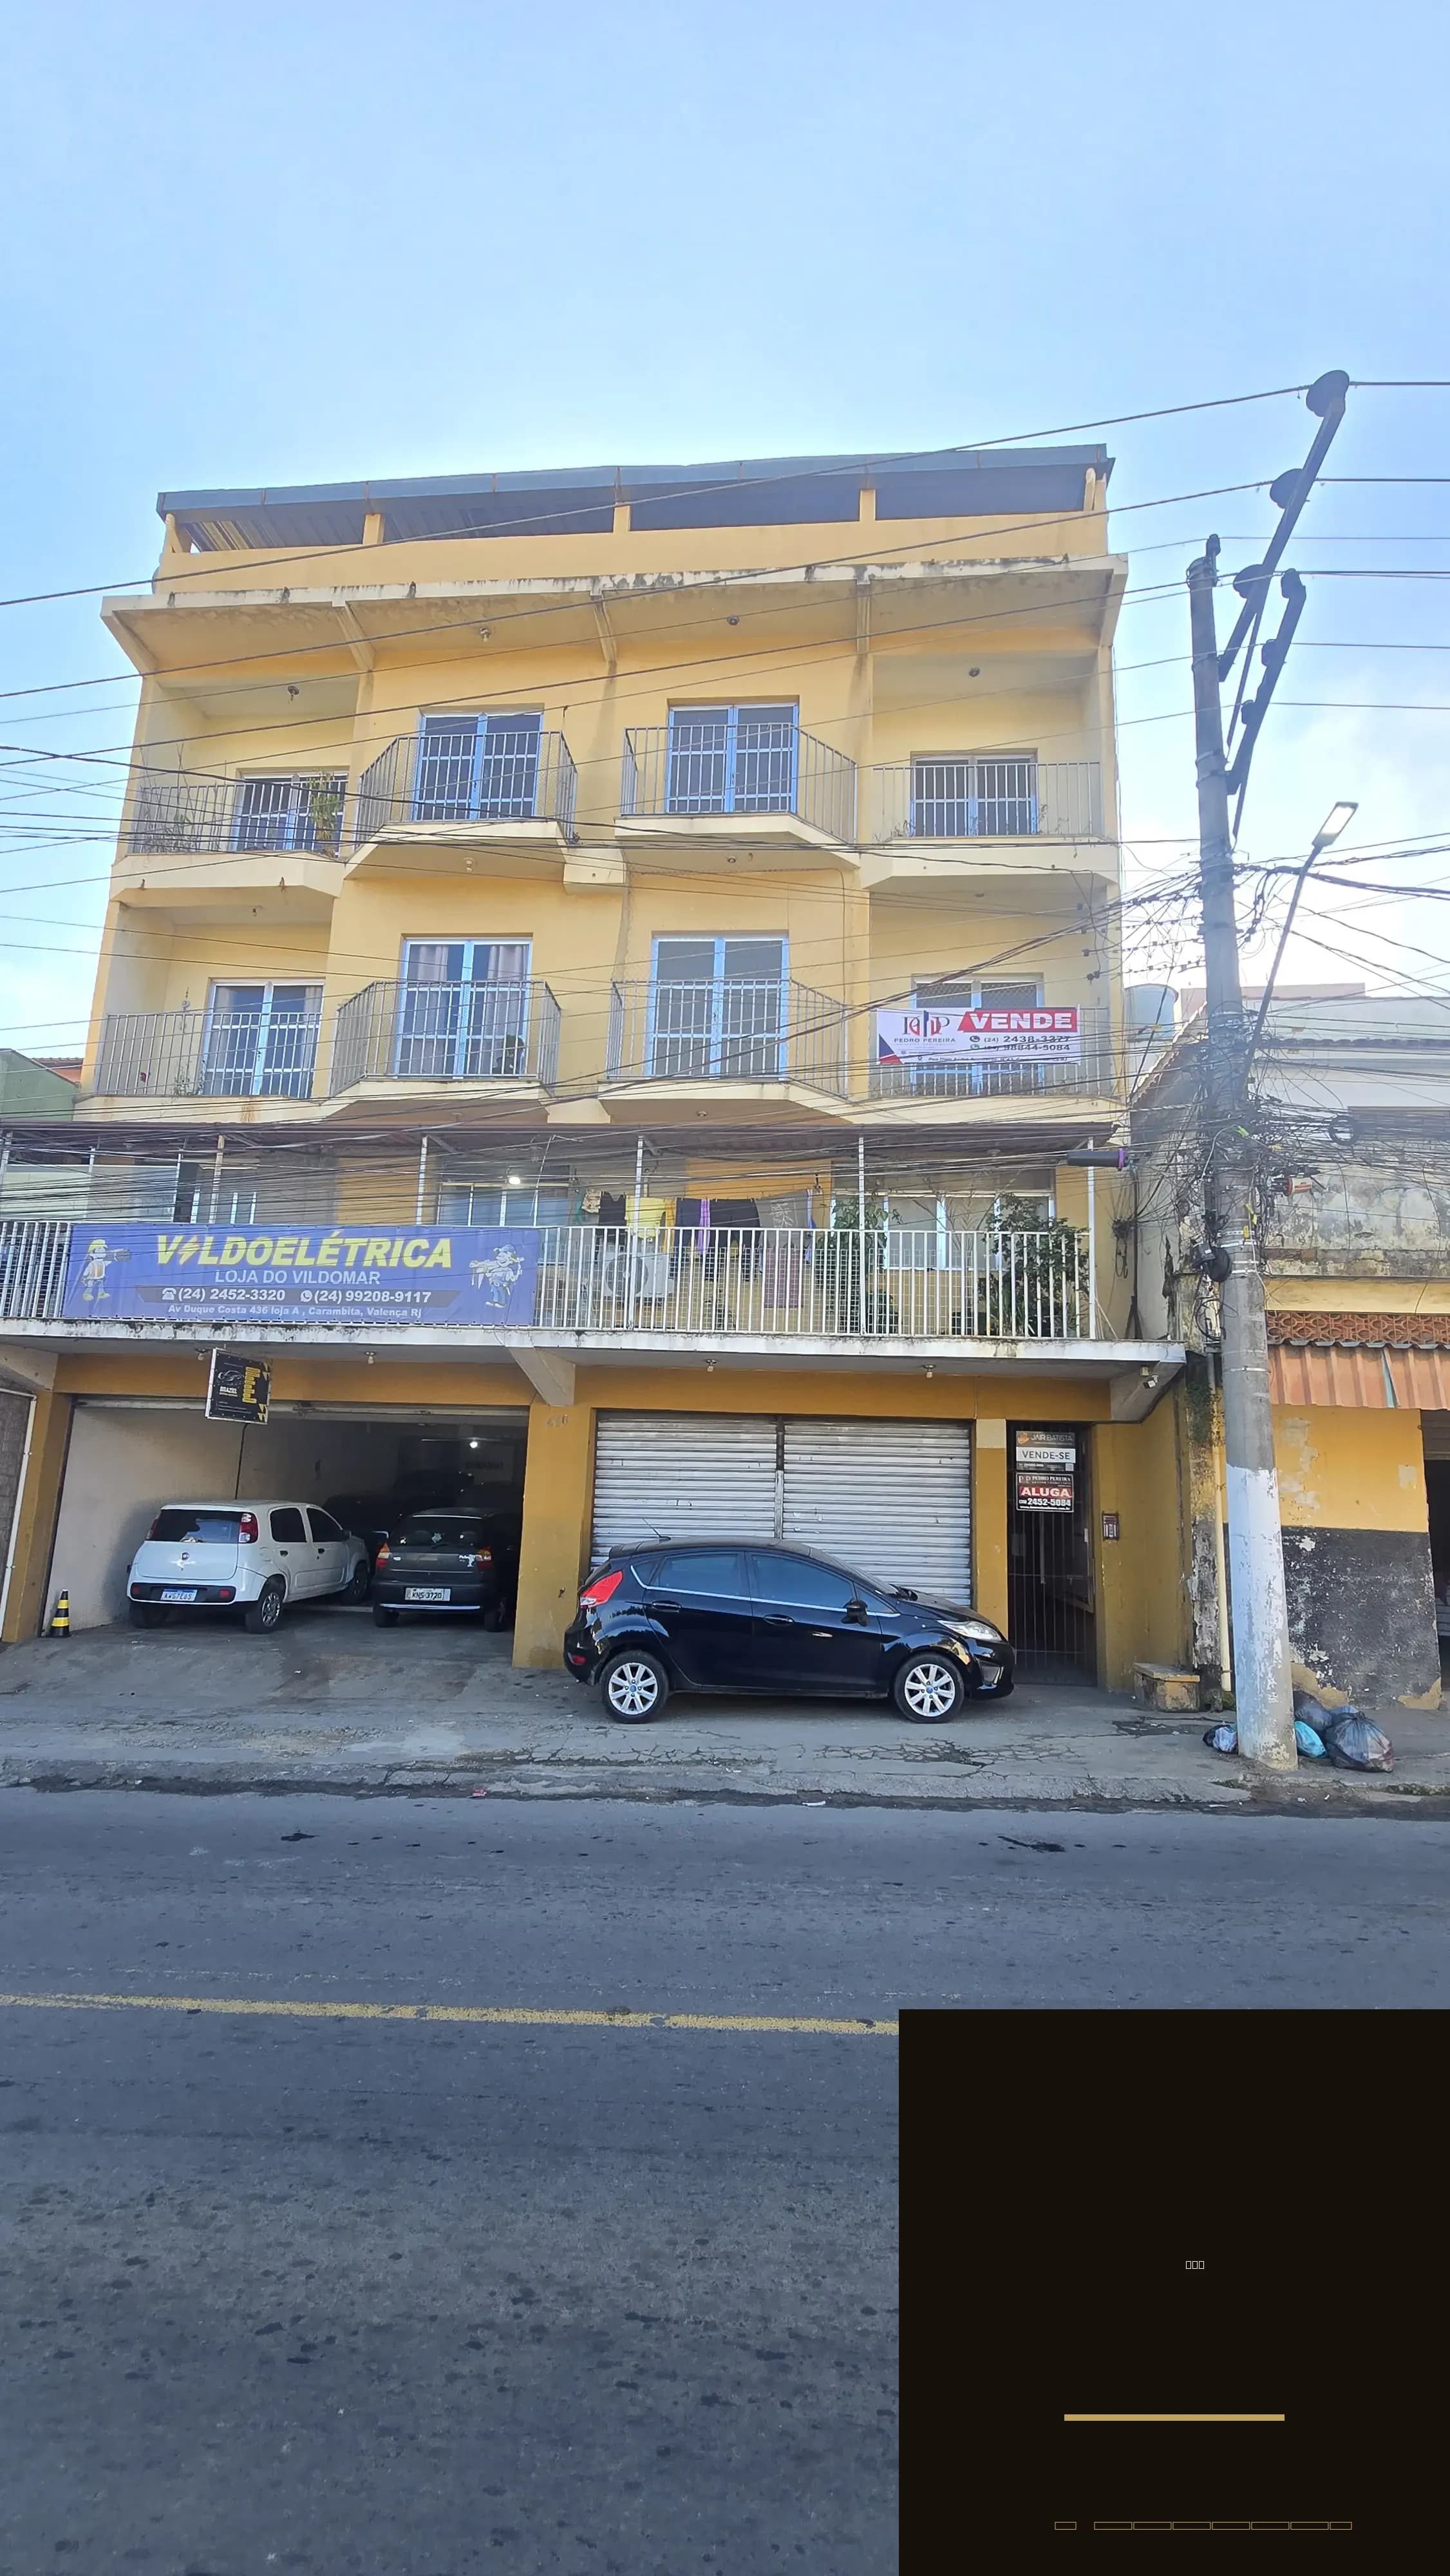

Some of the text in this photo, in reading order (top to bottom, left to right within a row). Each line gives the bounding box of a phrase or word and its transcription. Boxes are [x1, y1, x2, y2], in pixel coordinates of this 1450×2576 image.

[968, 1012, 1073, 1030] VENDE
[215, 1270, 381, 1285] LOJA DO VILDOMAR
[178, 1287, 431, 1304] (24) 2452-3320 (24) 99208-9117
[184, 1305, 214, 1314] Duque
[218, 1306, 247, 1314] Costa
[271, 1307, 289, 1316] loja
[367, 1307, 408, 1317] Valença
[1022, 1450, 1070, 1460] VENDE-SE
[1021, 1486, 1072, 1498] ALUGA
[1027, 1498, 1071, 1506] 2452-5084
